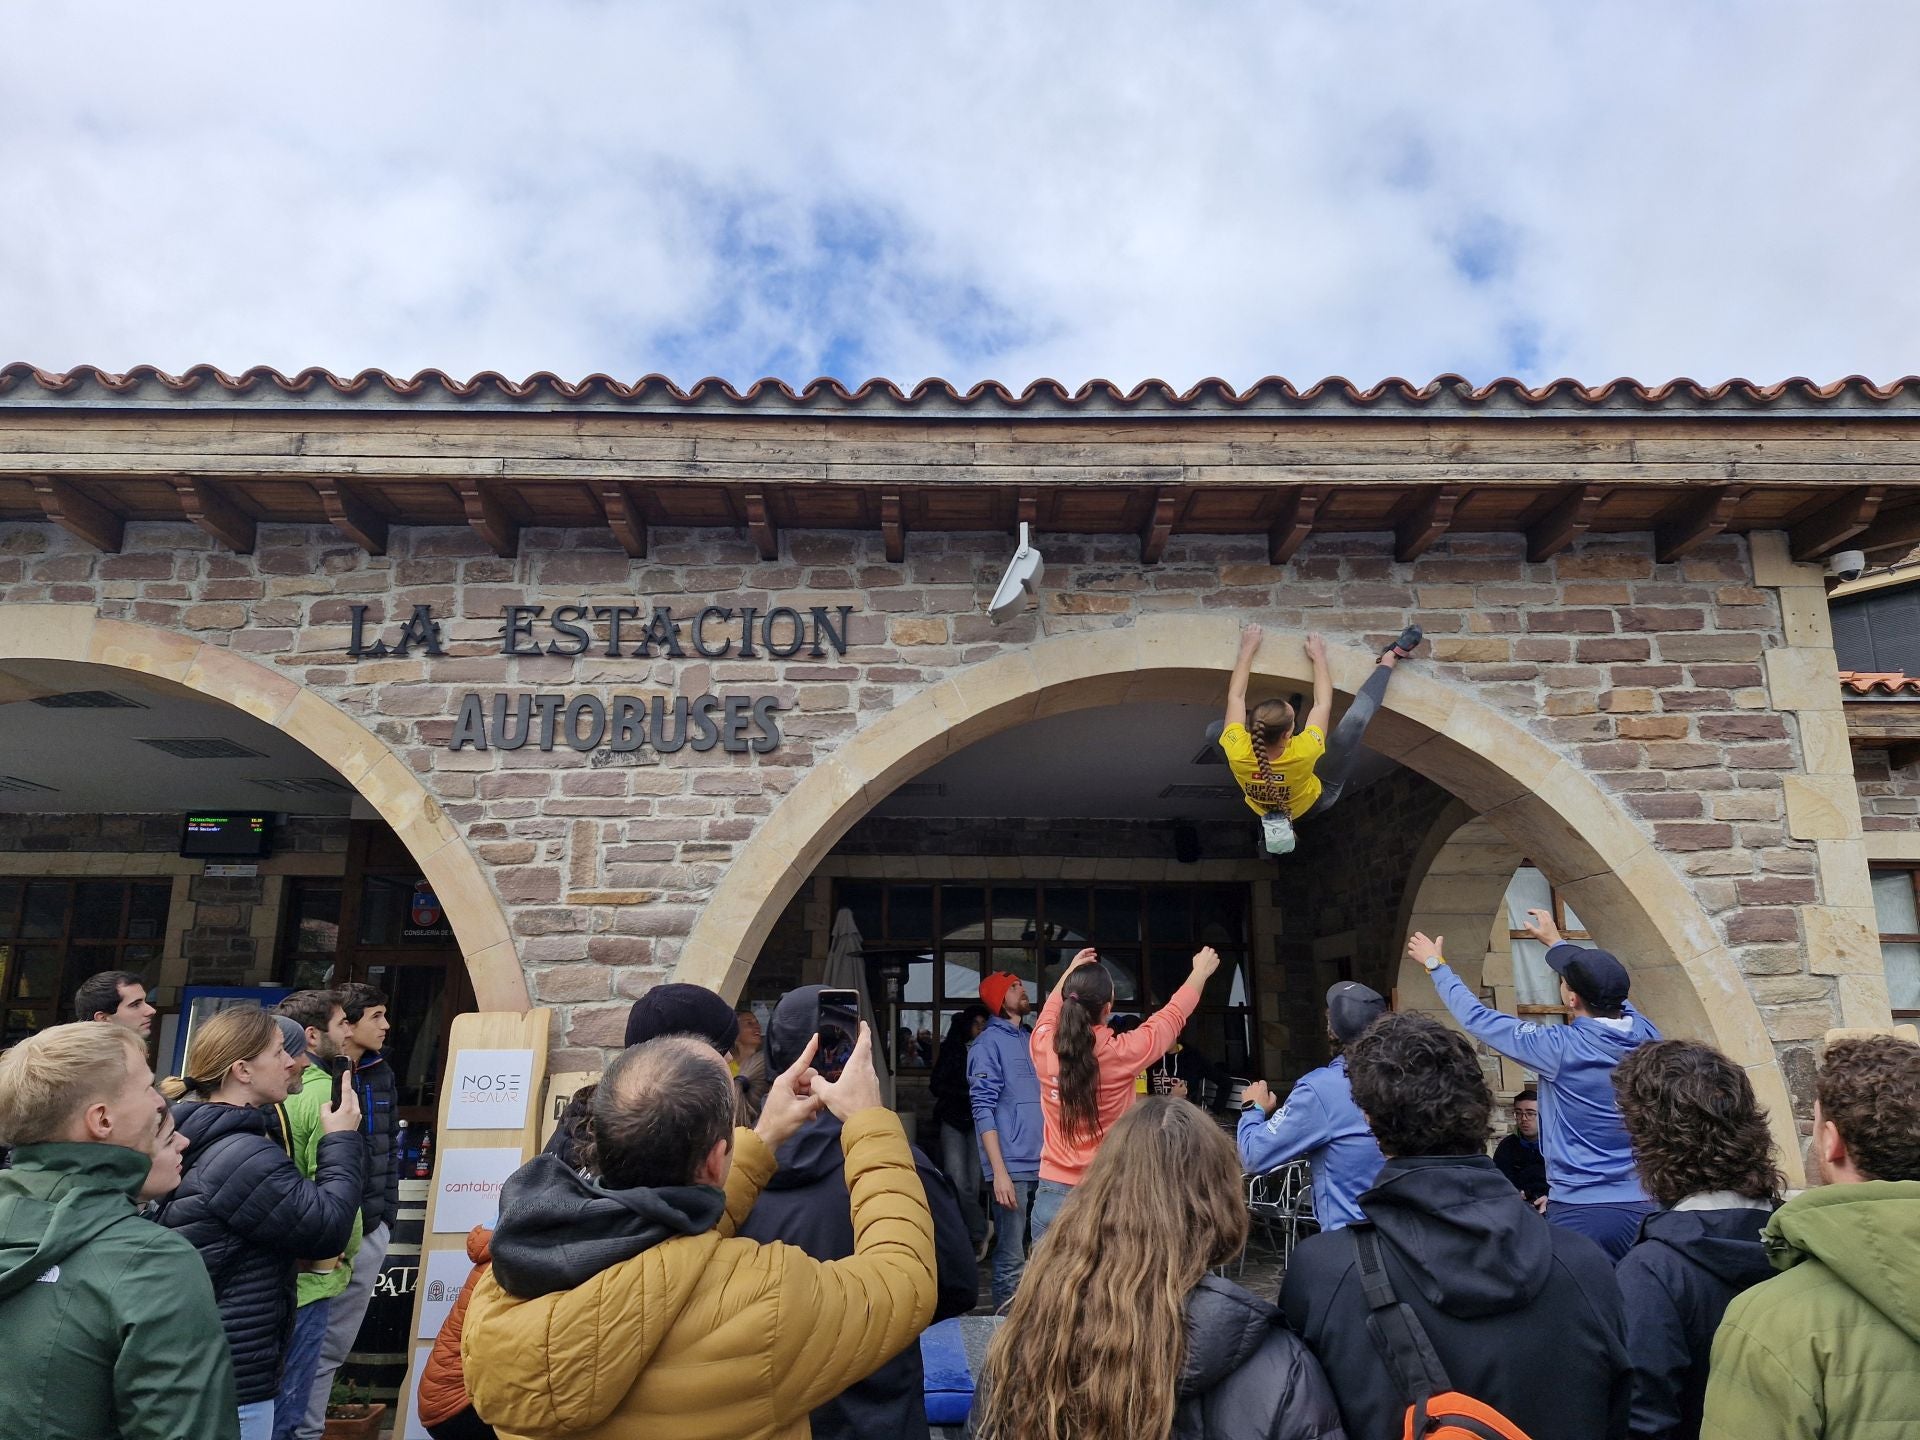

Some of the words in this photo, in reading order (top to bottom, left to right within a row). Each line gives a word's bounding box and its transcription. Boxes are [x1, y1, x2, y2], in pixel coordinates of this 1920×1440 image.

[346, 604, 446, 656] LA
[498, 605, 853, 657] ESTACION
[449, 694, 780, 753] AUTOBUSES
[460, 1091, 519, 1103] ESCALAR
